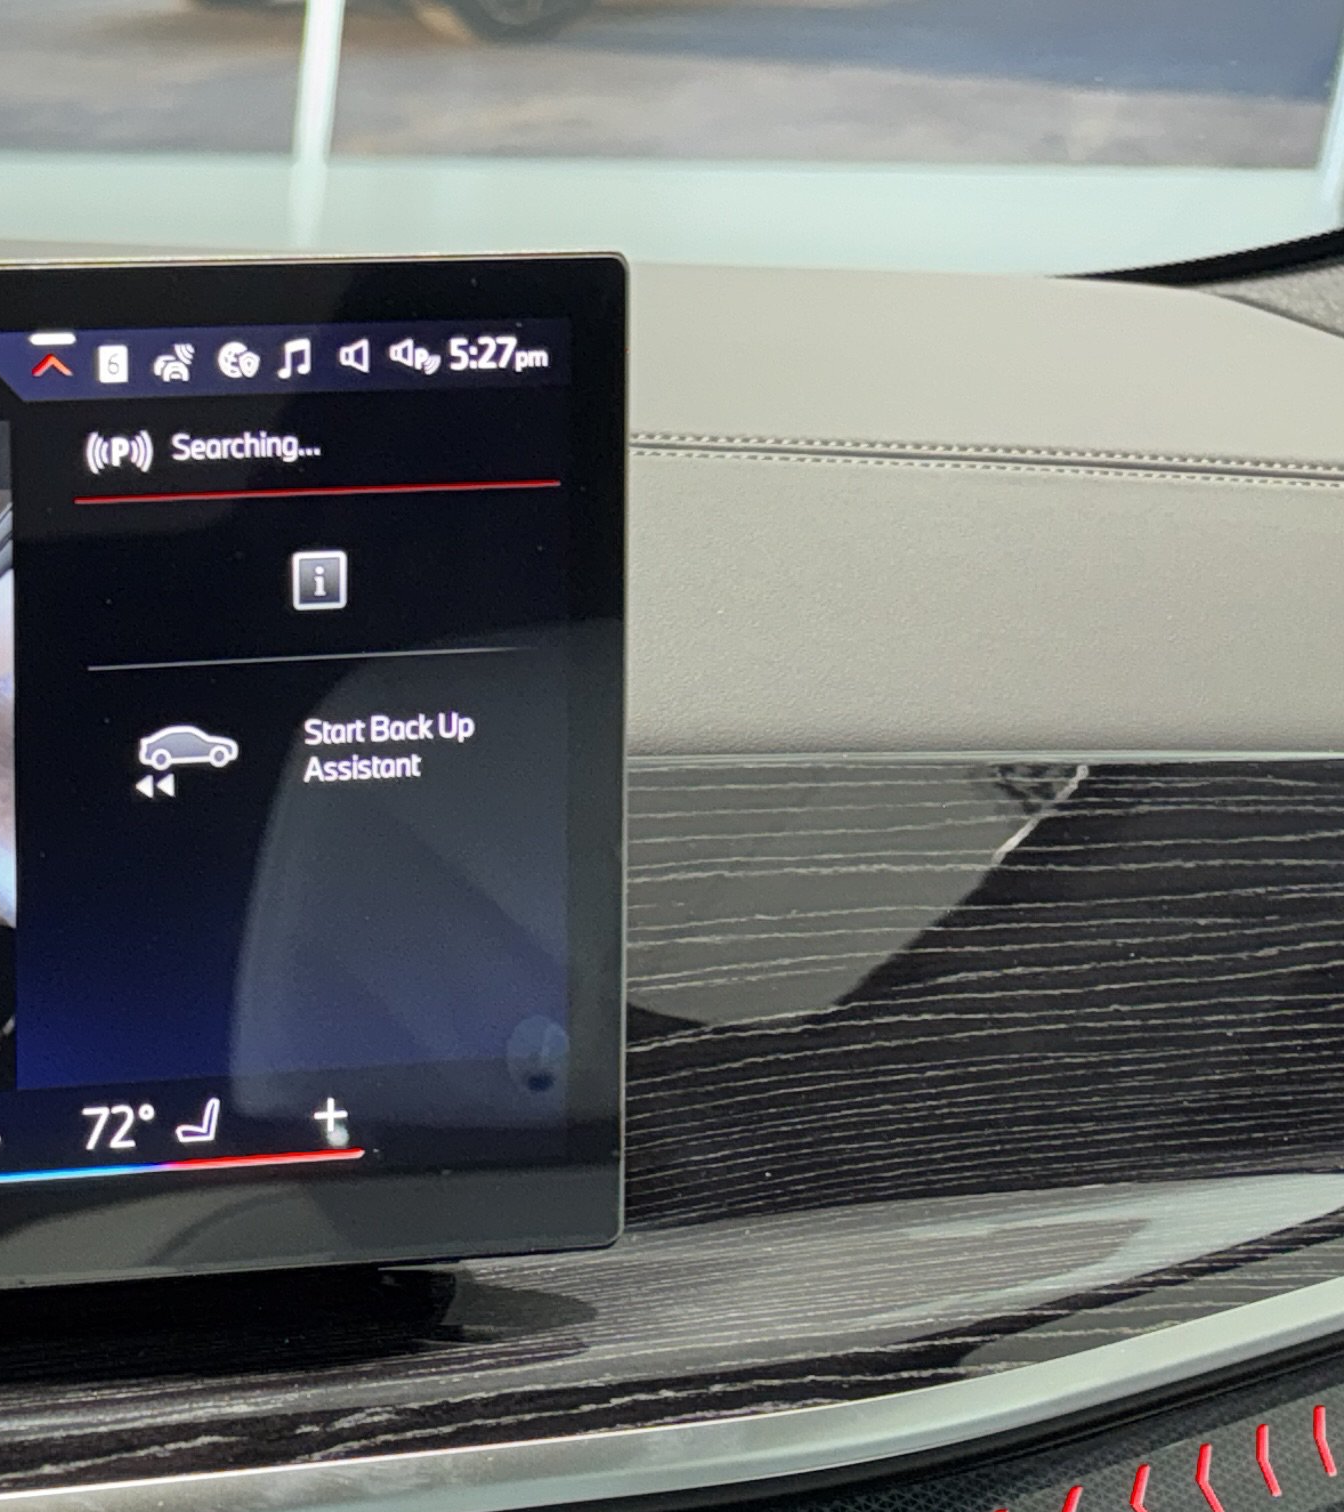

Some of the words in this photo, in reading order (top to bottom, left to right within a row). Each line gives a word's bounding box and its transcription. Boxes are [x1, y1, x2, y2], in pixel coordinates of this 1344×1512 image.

[449, 335, 549, 374] 5:27pm
[172, 431, 321, 463] Searching...
[304, 716, 365, 745] Start
[370, 714, 433, 740] Back
[438, 711, 475, 742] Up
[304, 753, 421, 783] Assistant
[82, 1104, 154, 1151] 72°
